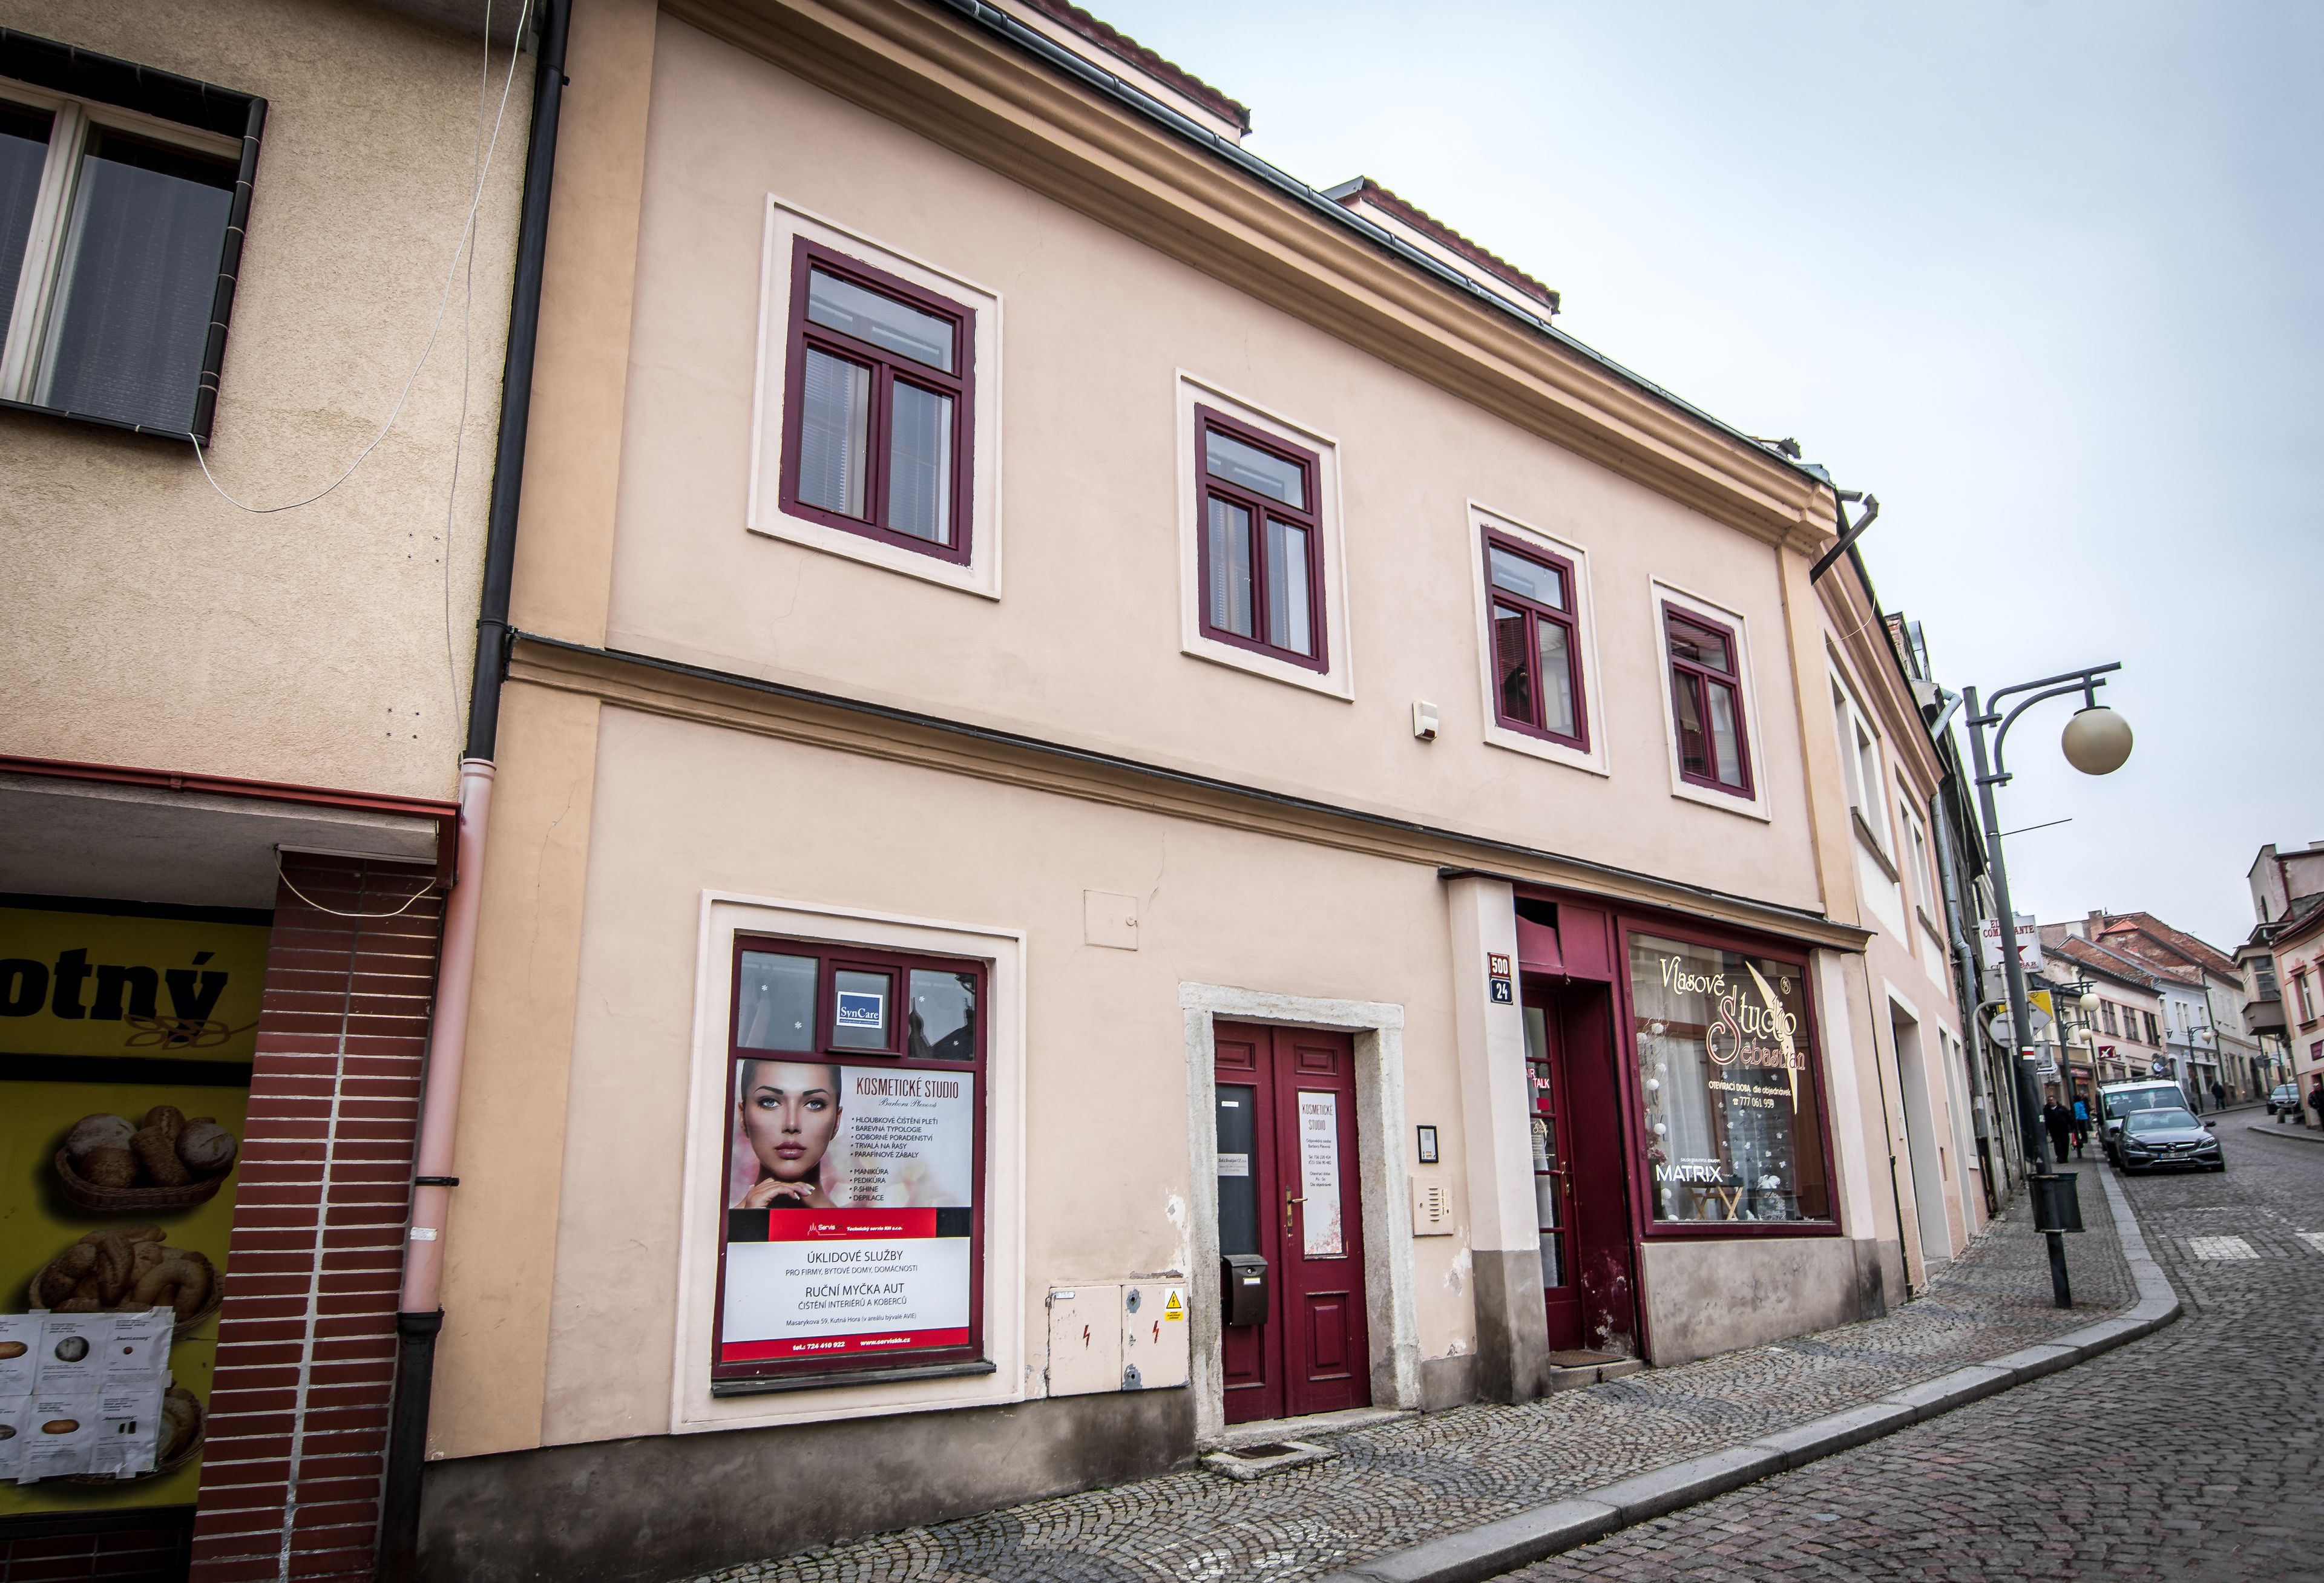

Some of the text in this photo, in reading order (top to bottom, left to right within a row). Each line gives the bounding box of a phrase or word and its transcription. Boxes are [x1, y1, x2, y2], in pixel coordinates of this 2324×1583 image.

[1983, 925, 2034, 938] COMANTE
[1492, 957, 1508, 974] 500
[1659, 955, 1725, 996] Vlasové
[1496, 983, 1508, 1000] 24
[841, 1006, 879, 1019] SynCare
[1706, 985, 1797, 1065] Studio
[856, 1077, 959, 1098] KOSMETICKÉ STUDIO
[1532, 1078, 1550, 1089] TALK
[1708, 1080, 1735, 1091] OTEVÍRACÍ
[1753, 1085, 1762, 1093] dle
[878, 1097, 908, 1106] Barbora
[1739, 1096, 1774, 1109] 777 061 959
[1302, 1103, 1333, 1116] KOSMETICKÉ
[1308, 1119, 1326, 1130] STUDIO
[1655, 1164, 1723, 1182] MATRIX
[807, 1249, 904, 1263] ÚKLIDOVÉ SLUŽBY
[824, 1267, 850, 1275] BYTOVÉ
[875, 1265, 918, 1273] DOMÁCNOSTI
[806, 1282, 905, 1298] RUČNÍ MYČKA AUT
[798, 1299, 827, 1310] ČIŠTĚNÍ
[828, 1297, 865, 1308] INTERIÉRŮ
[873, 1296, 907, 1306] KOBERCŮ
[786, 1319, 819, 1327] Masarykova
[860, 1337, 911, 1346] www.serviskh.cz
